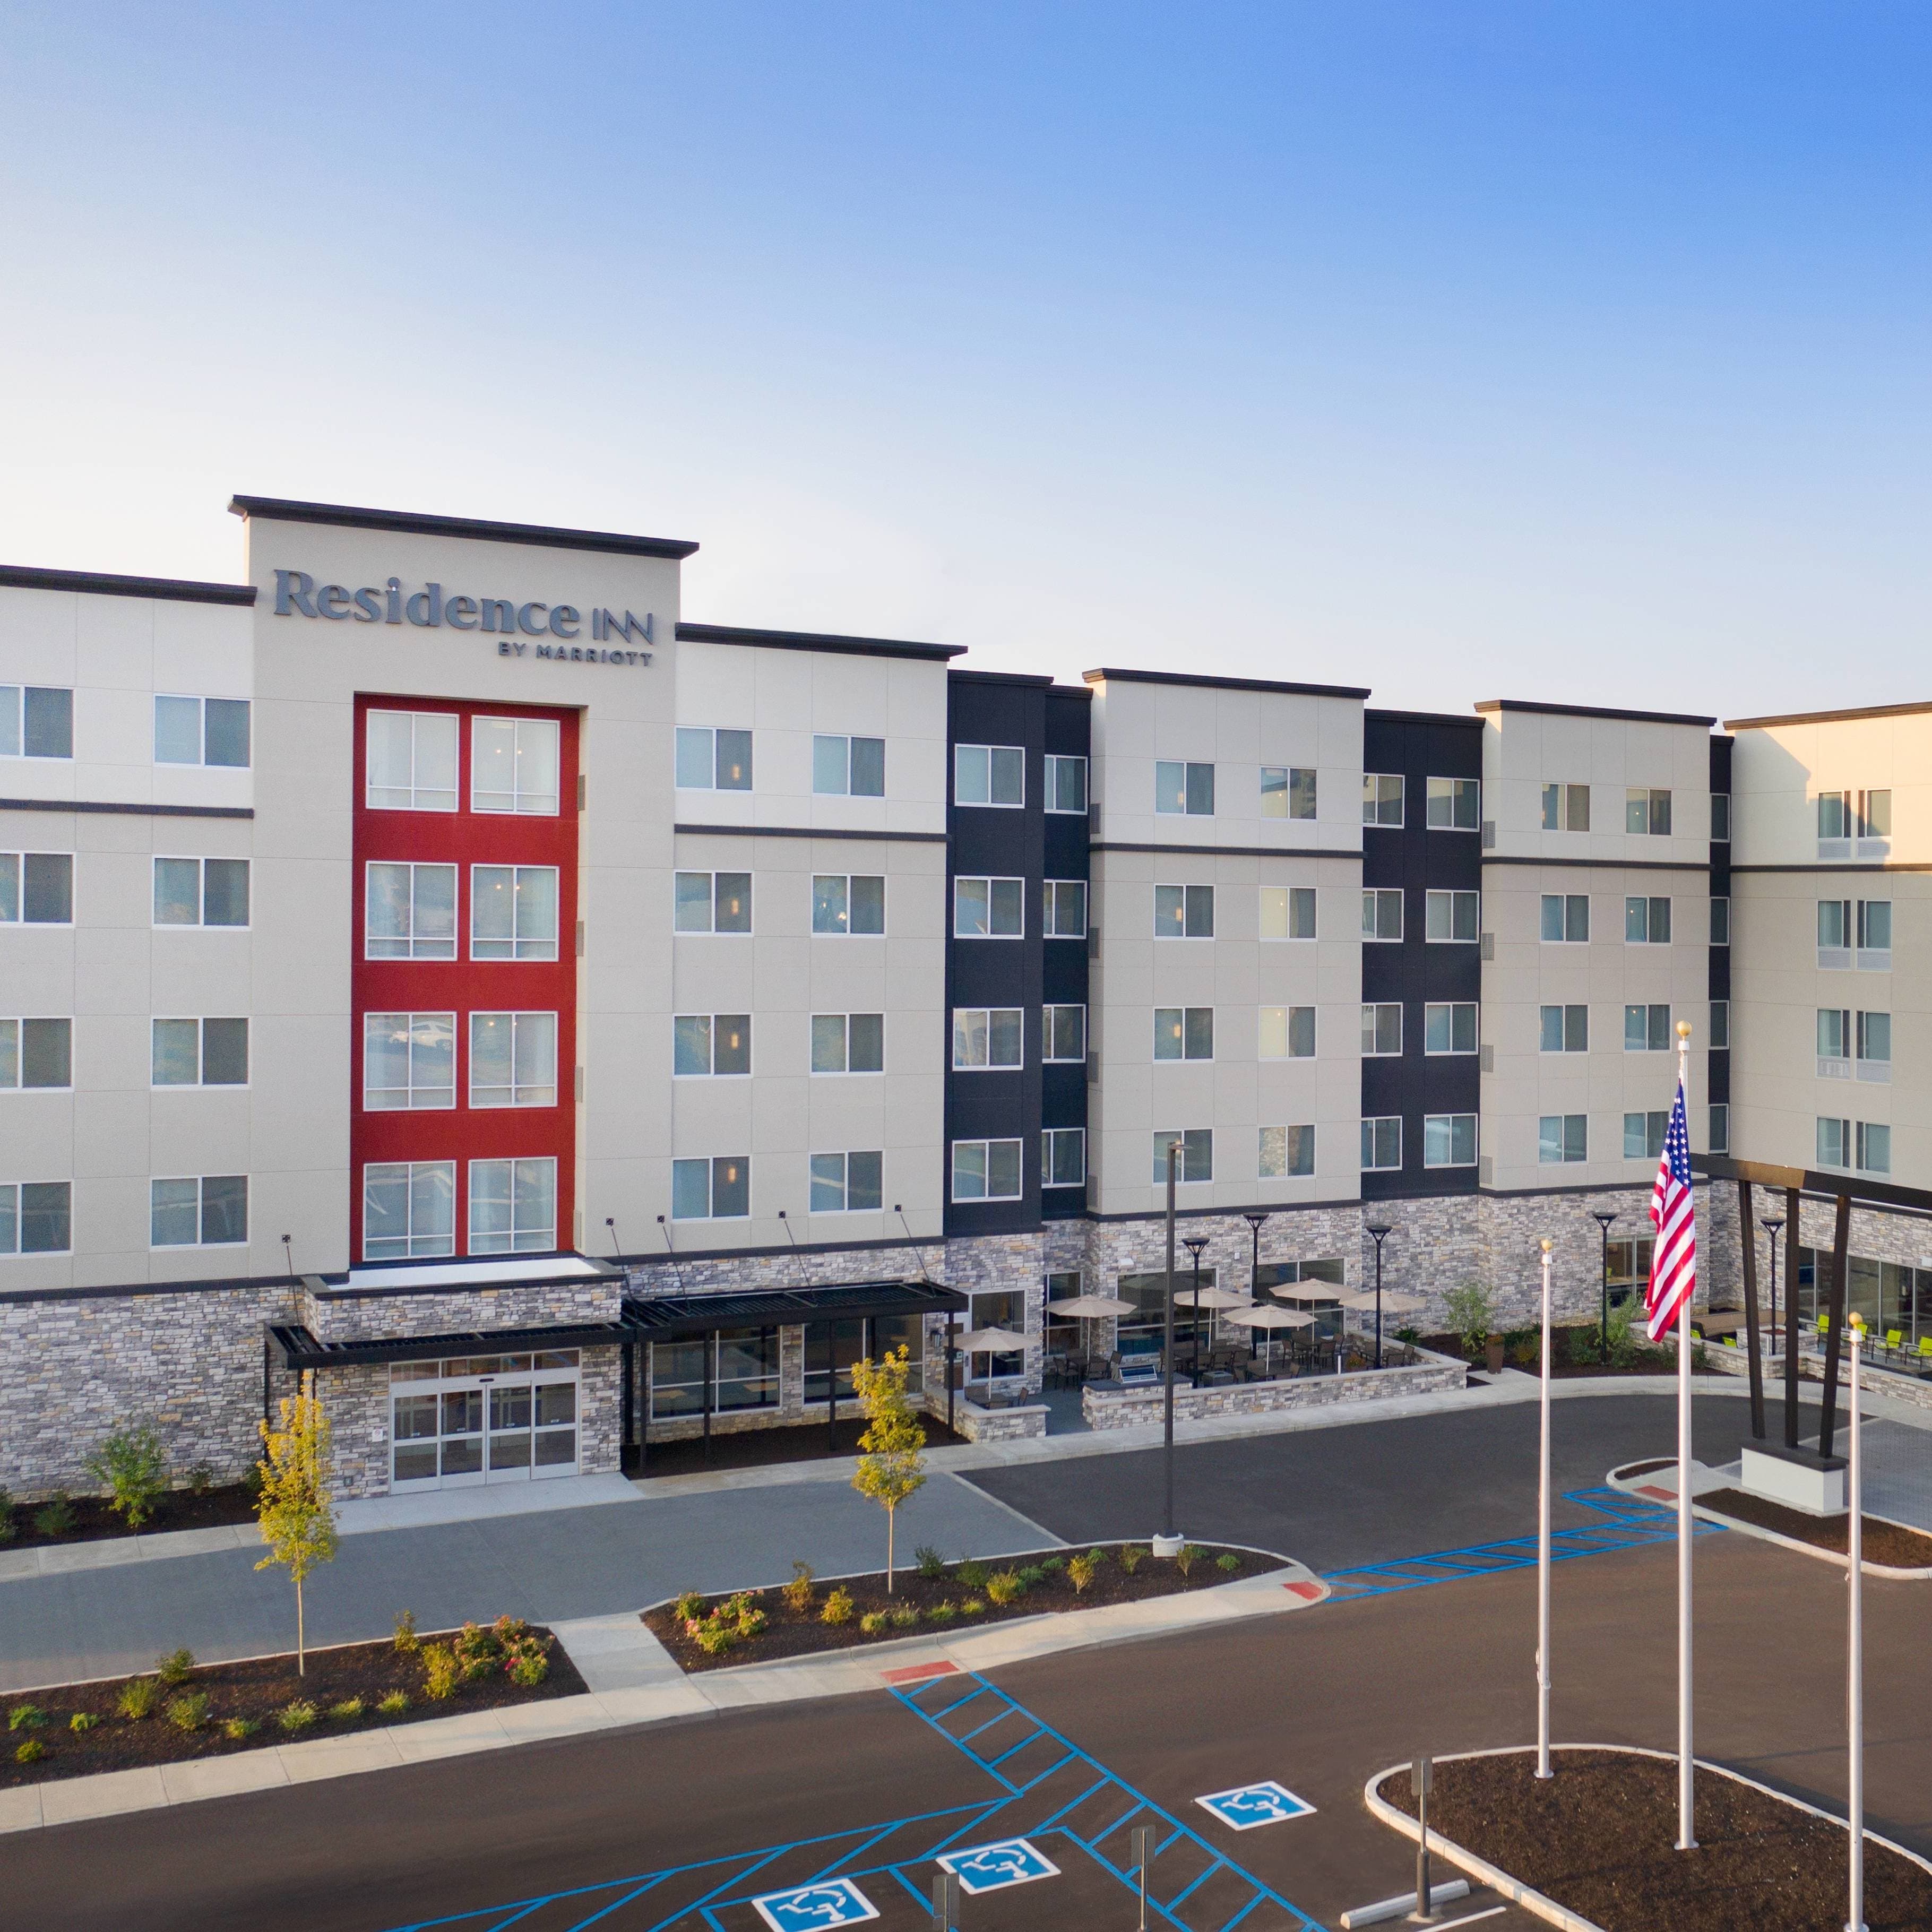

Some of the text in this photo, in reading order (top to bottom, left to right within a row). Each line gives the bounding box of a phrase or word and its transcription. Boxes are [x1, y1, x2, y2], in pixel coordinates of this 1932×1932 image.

[273, 569, 653, 644] Residence INN
[498, 642, 653, 667] BY MARRIOTT
